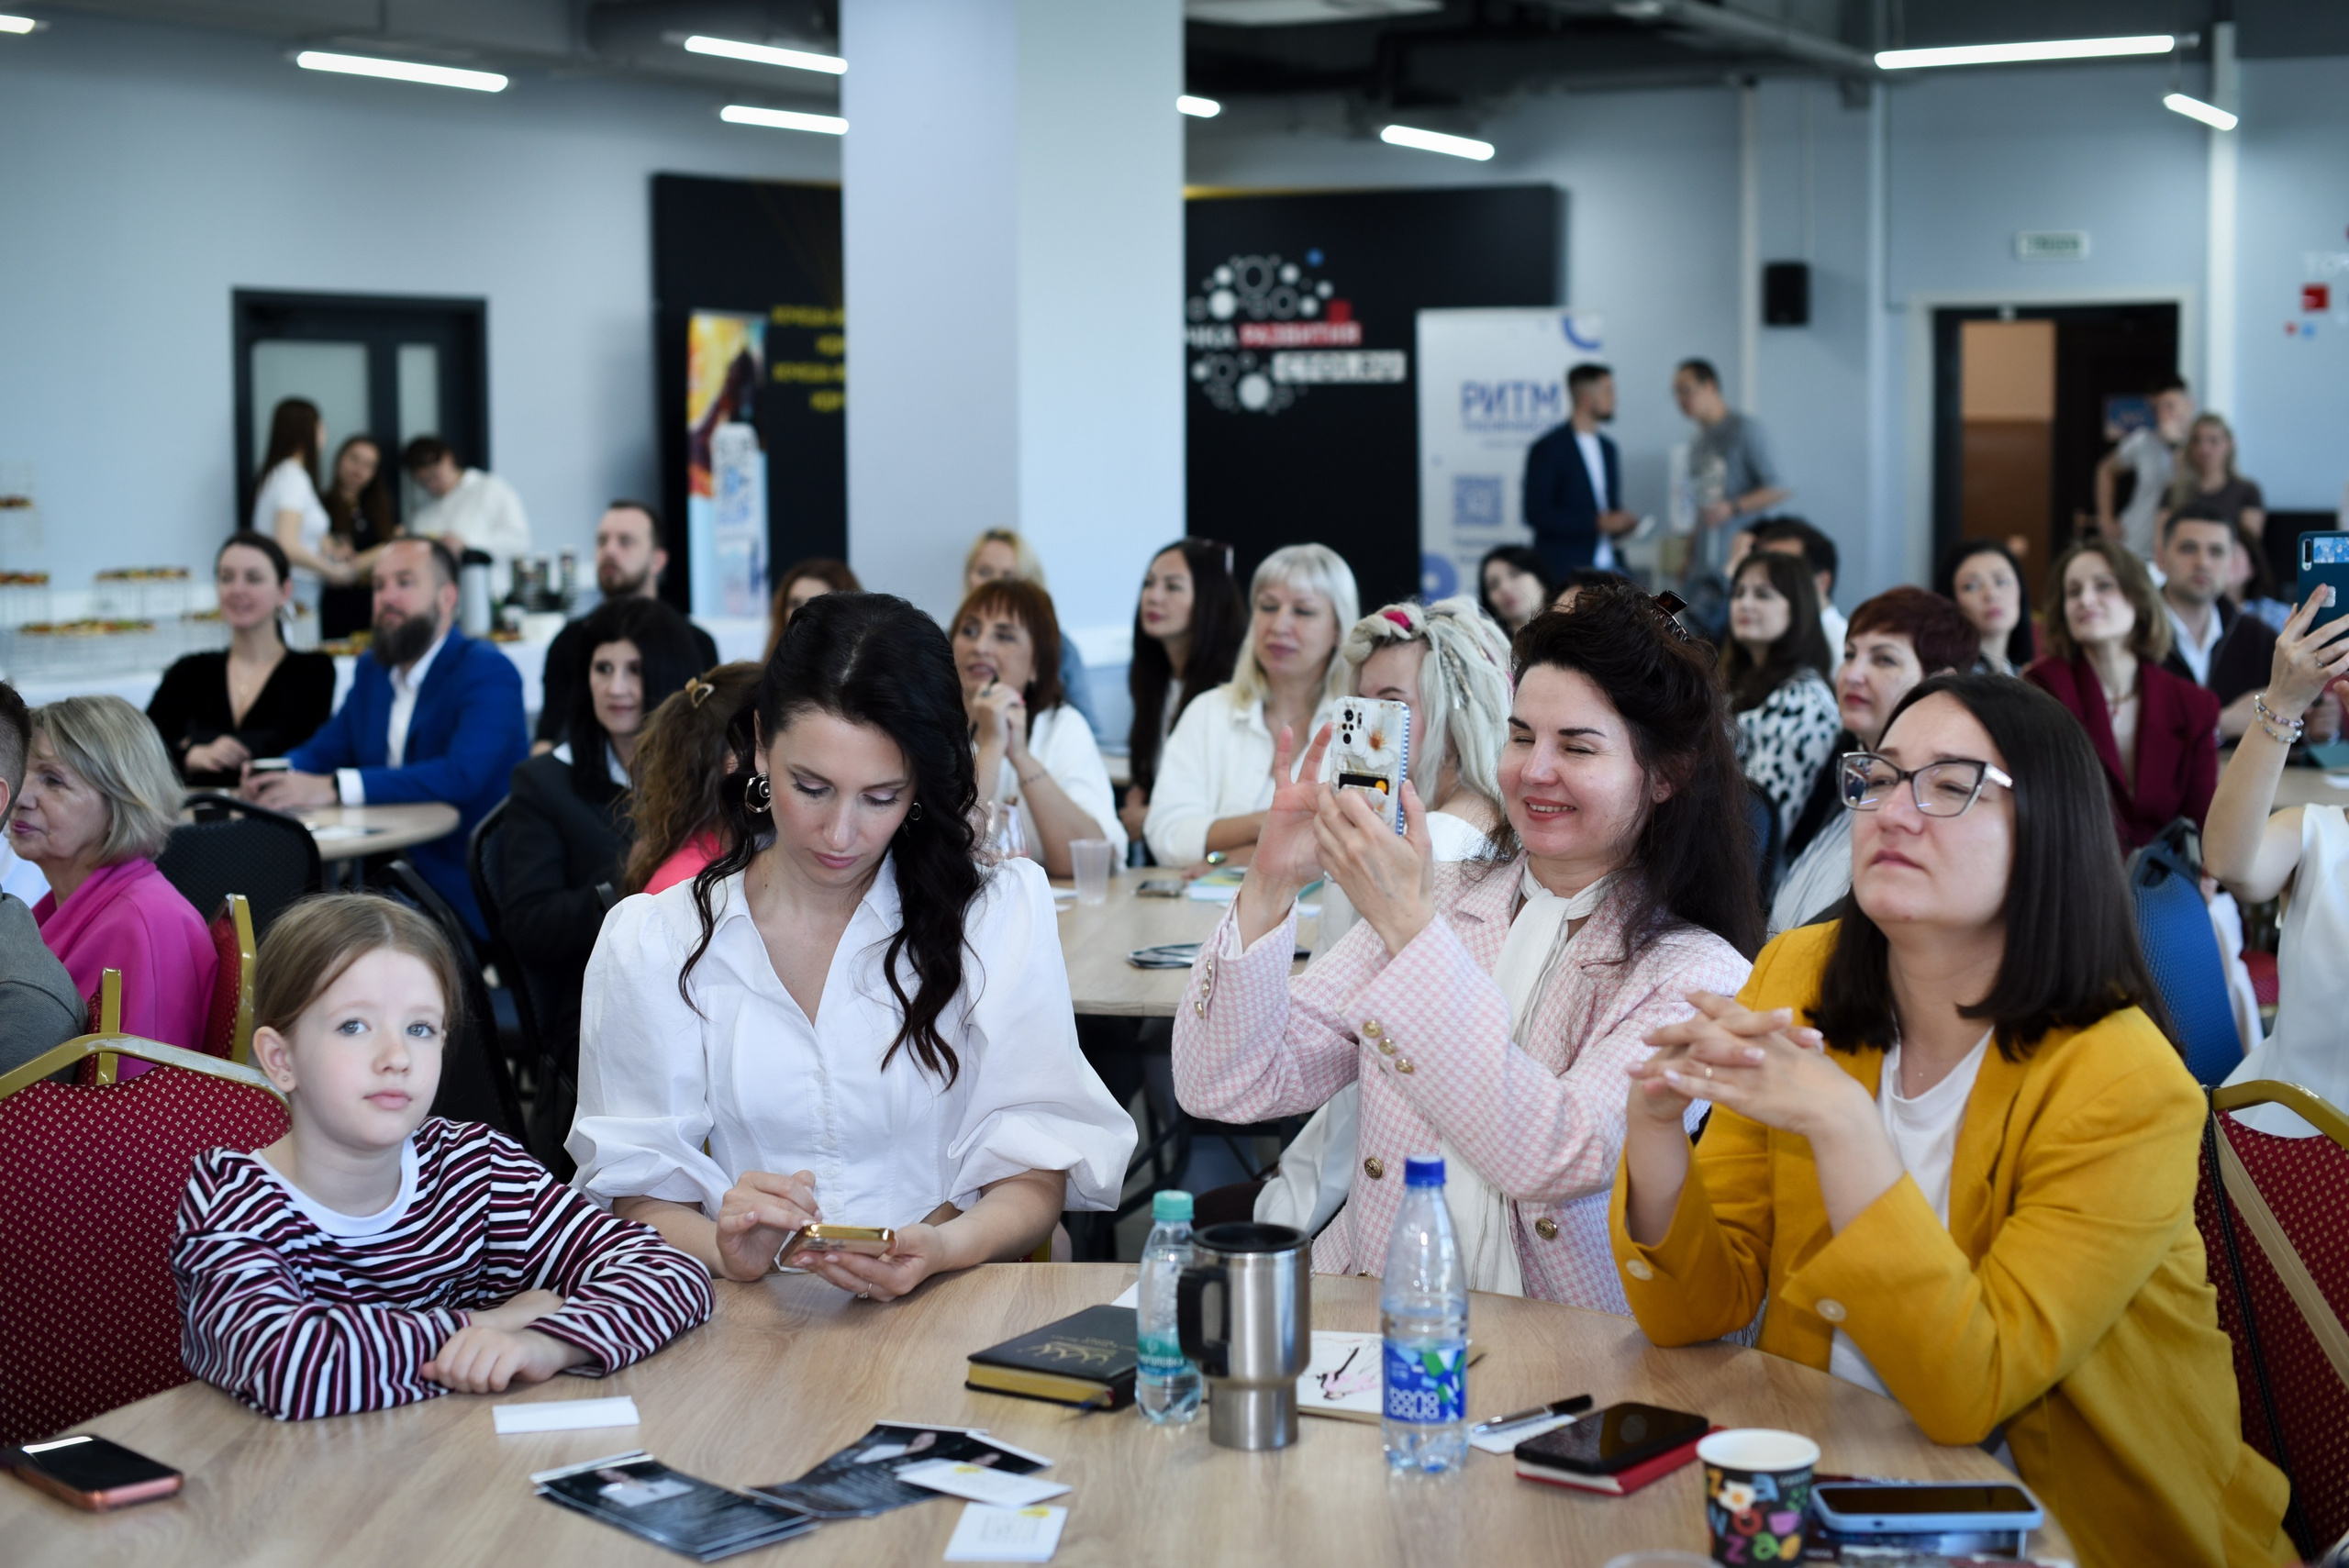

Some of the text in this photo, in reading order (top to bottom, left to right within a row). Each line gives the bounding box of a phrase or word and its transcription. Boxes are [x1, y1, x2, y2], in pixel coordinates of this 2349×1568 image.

[1461, 381, 1561, 417] РИТМ
[1389, 1385, 1441, 1406] bona
[1389, 1403, 1441, 1421] aqua
